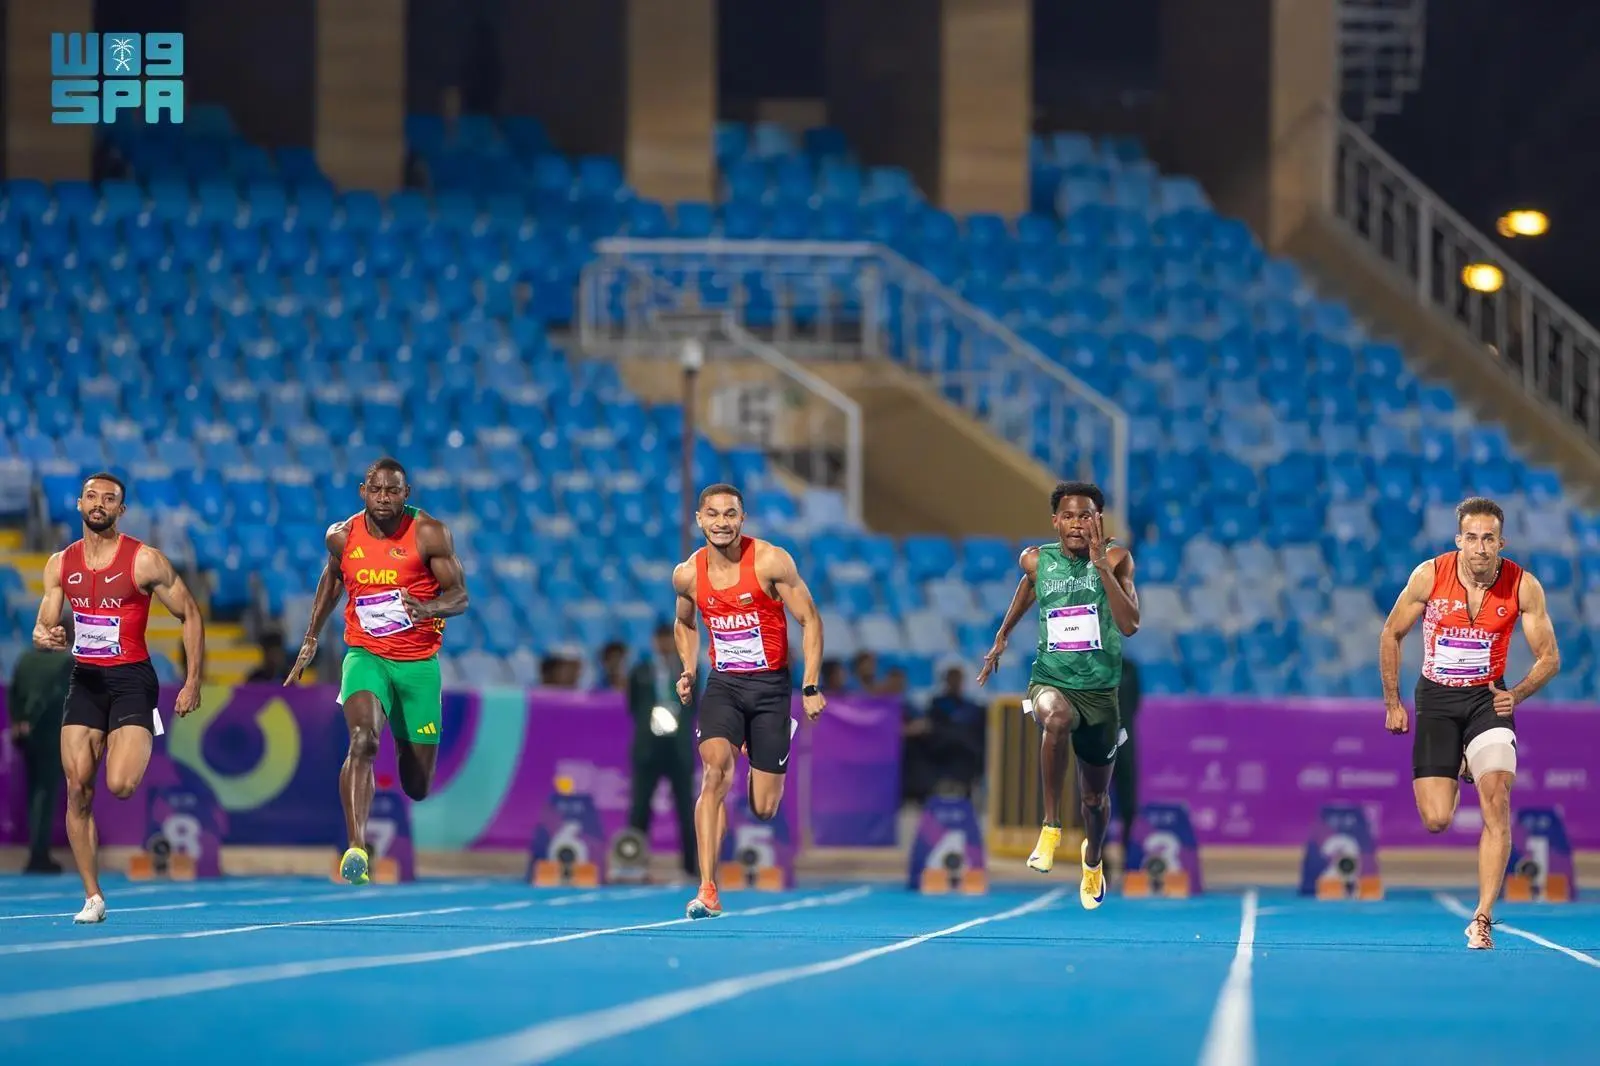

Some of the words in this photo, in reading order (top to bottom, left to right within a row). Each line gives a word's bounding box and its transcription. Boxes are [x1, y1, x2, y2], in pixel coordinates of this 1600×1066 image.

[356, 568, 398, 585] CMR
[163, 813, 202, 859] 8
[366, 818, 397, 858] 7
[548, 820, 589, 866] 6
[737, 826, 775, 868] 5
[926, 830, 974, 870] 4
[1525, 836, 1550, 886] 1
